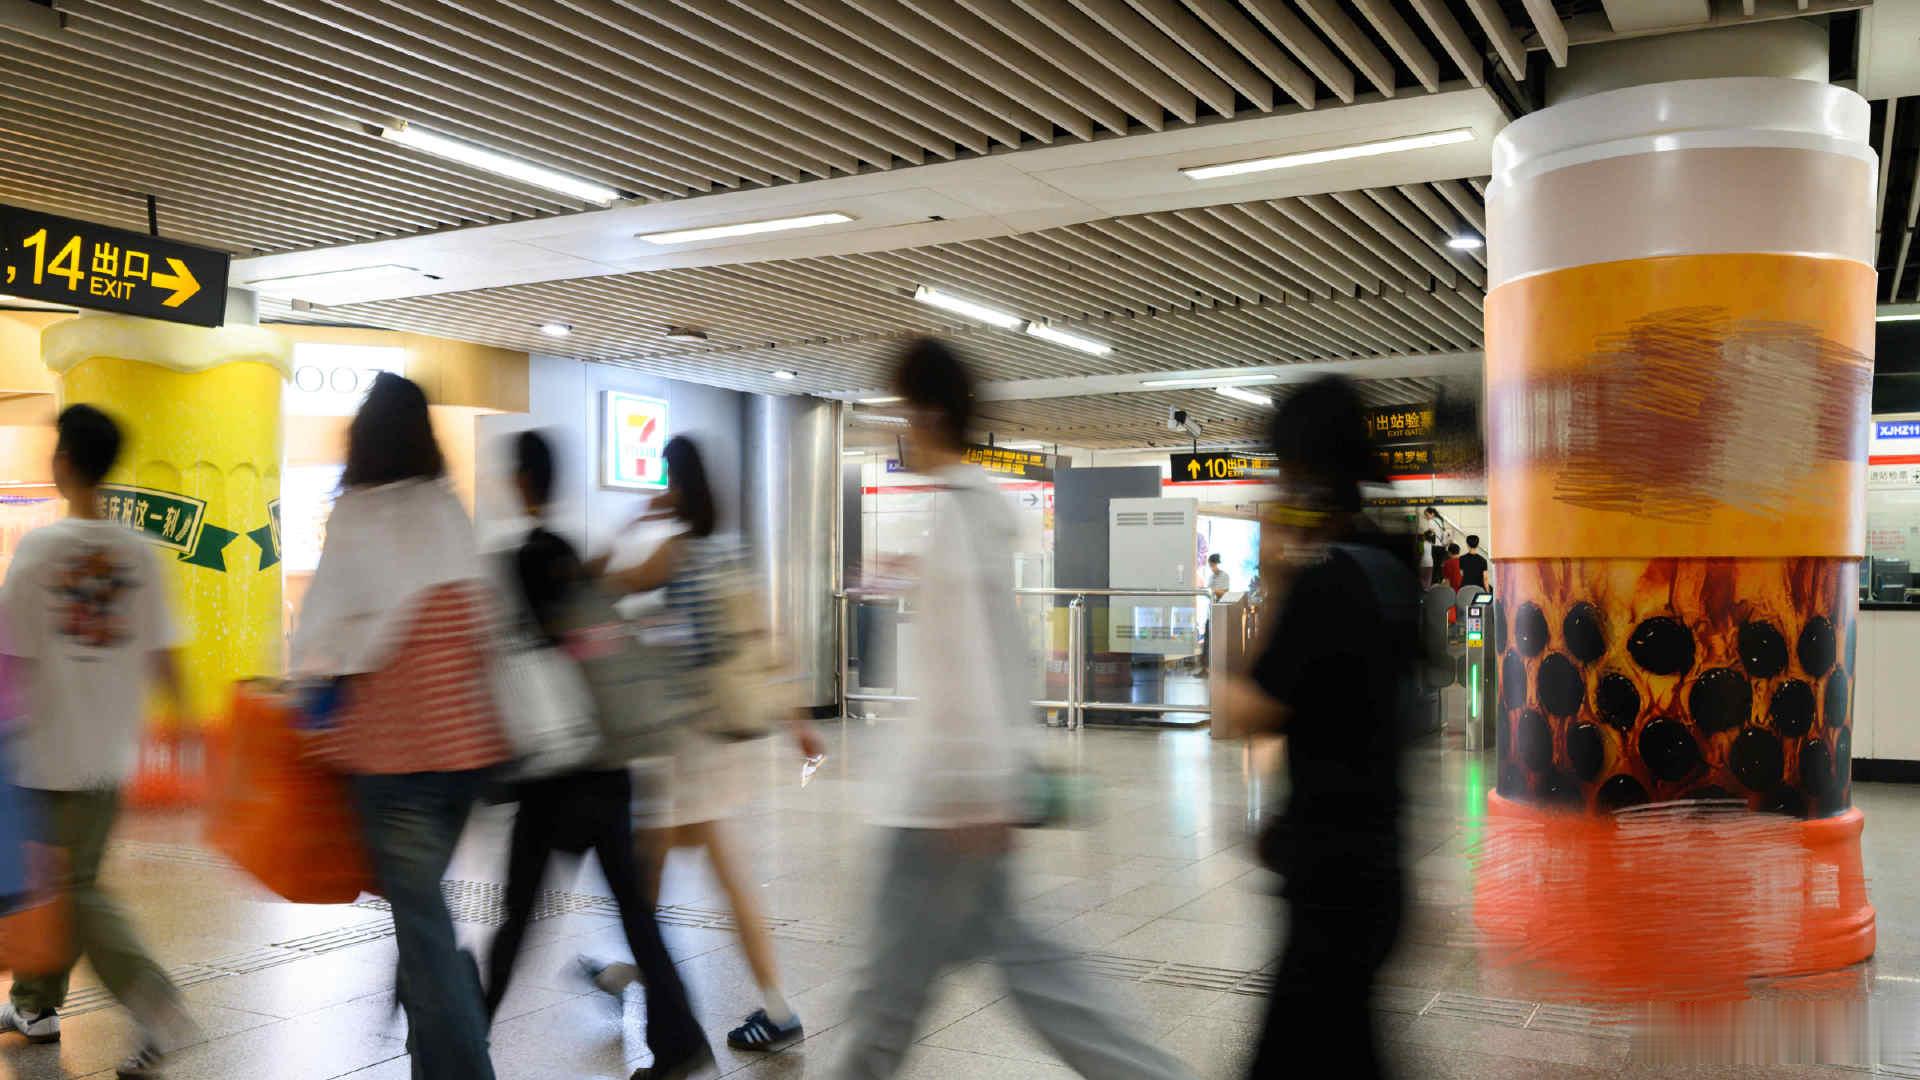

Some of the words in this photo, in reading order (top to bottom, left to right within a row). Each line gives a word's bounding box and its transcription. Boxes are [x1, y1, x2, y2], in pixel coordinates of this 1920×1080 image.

[92, 242, 149, 280] 出口
[90, 276, 136, 299] EXIT
[1205, 458, 1227, 478] 10
[1227, 458, 1248, 470] 出口
